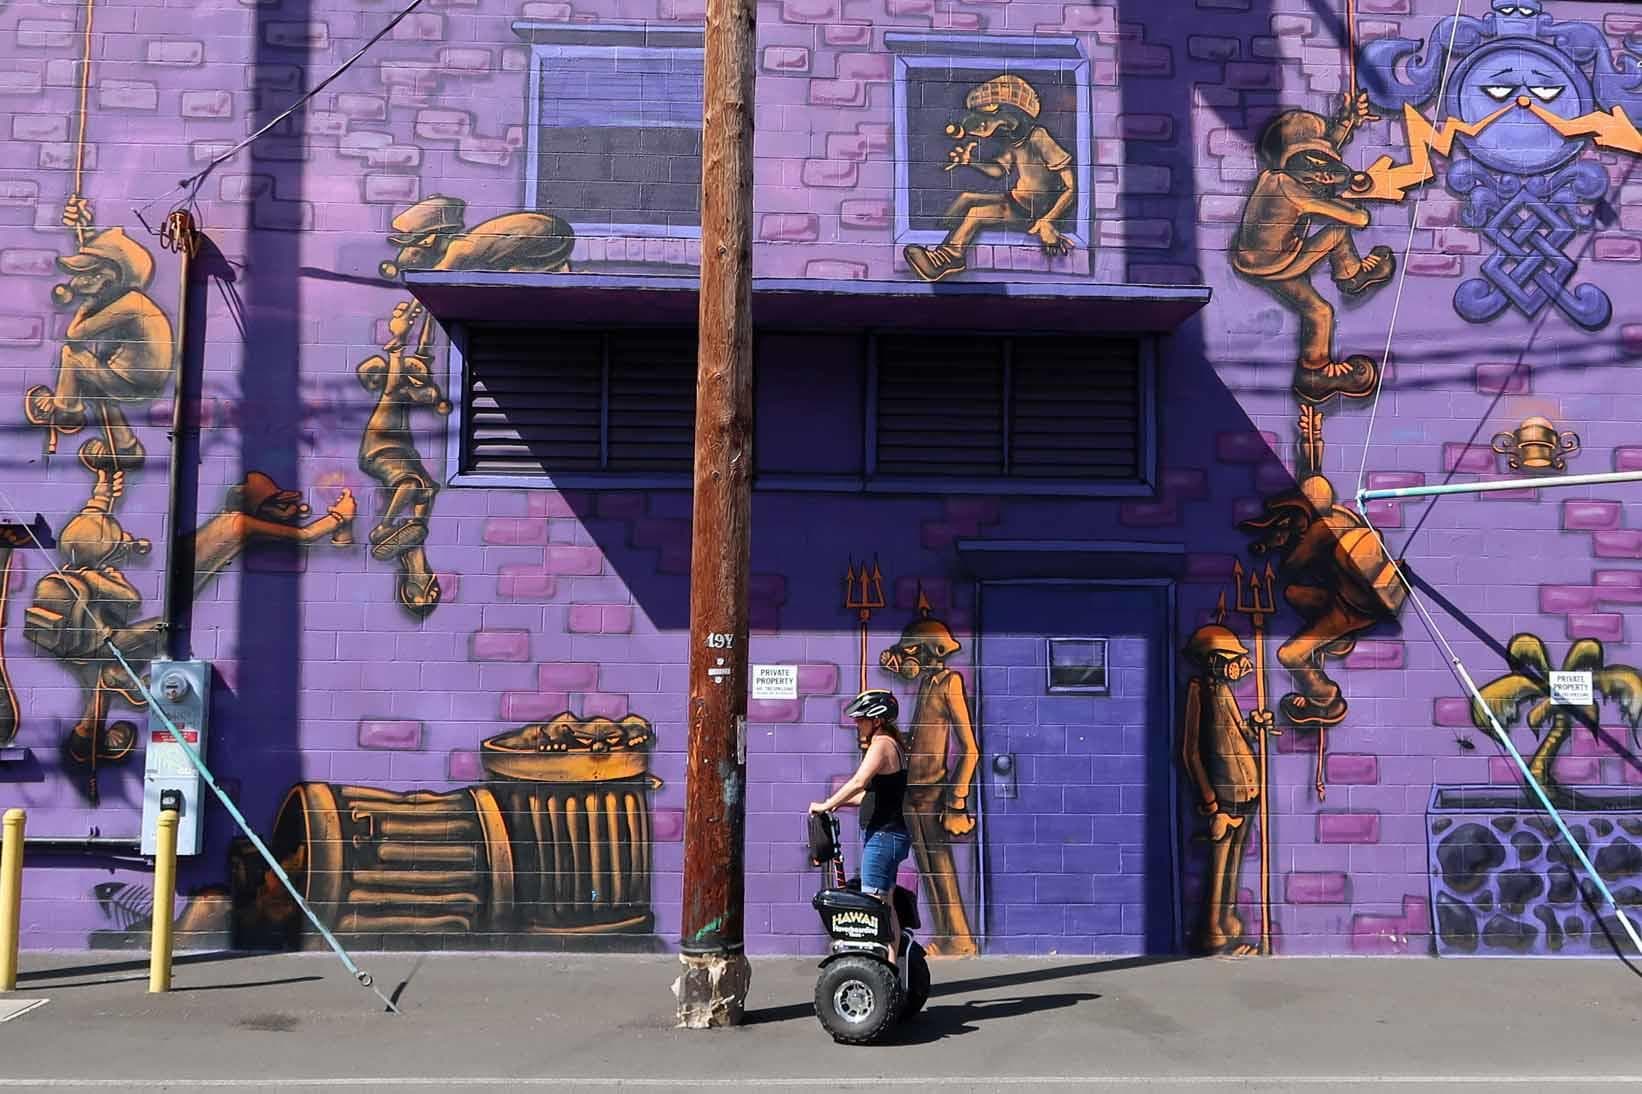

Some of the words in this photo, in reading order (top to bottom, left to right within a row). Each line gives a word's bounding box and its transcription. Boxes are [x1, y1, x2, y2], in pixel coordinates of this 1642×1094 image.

[760, 669, 790, 677] PRIVATE
[756, 677, 794, 685] PROPERTY
[1557, 675, 1585, 683] PRIVATE
[1553, 683, 1588, 691] PROPERTY
[832, 911, 878, 929] HAWAII
